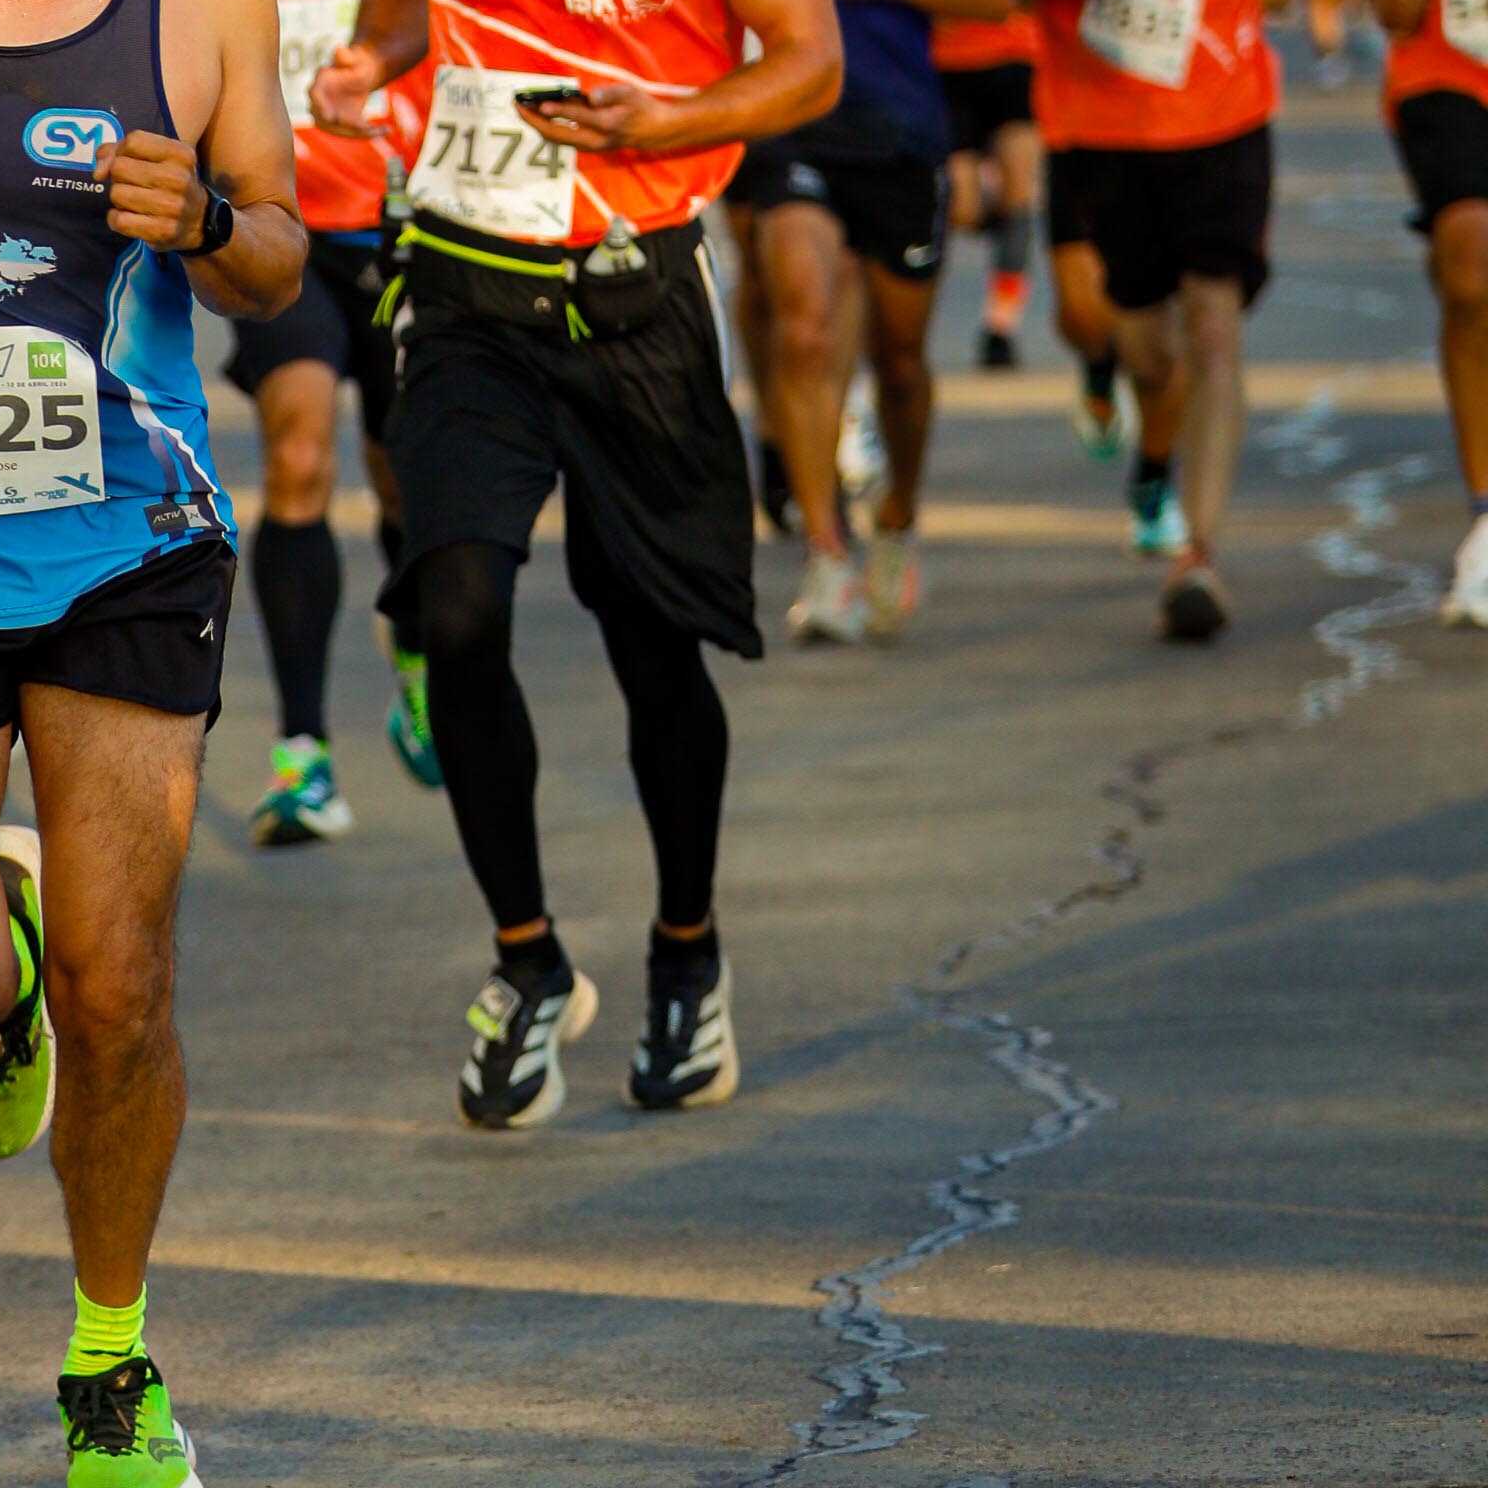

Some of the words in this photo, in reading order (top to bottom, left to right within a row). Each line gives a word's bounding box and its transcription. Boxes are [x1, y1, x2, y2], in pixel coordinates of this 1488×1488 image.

[428, 120, 566, 179] 7174
[31, 176, 105, 194] ATLETISMO
[31, 352, 64, 369] 10K
